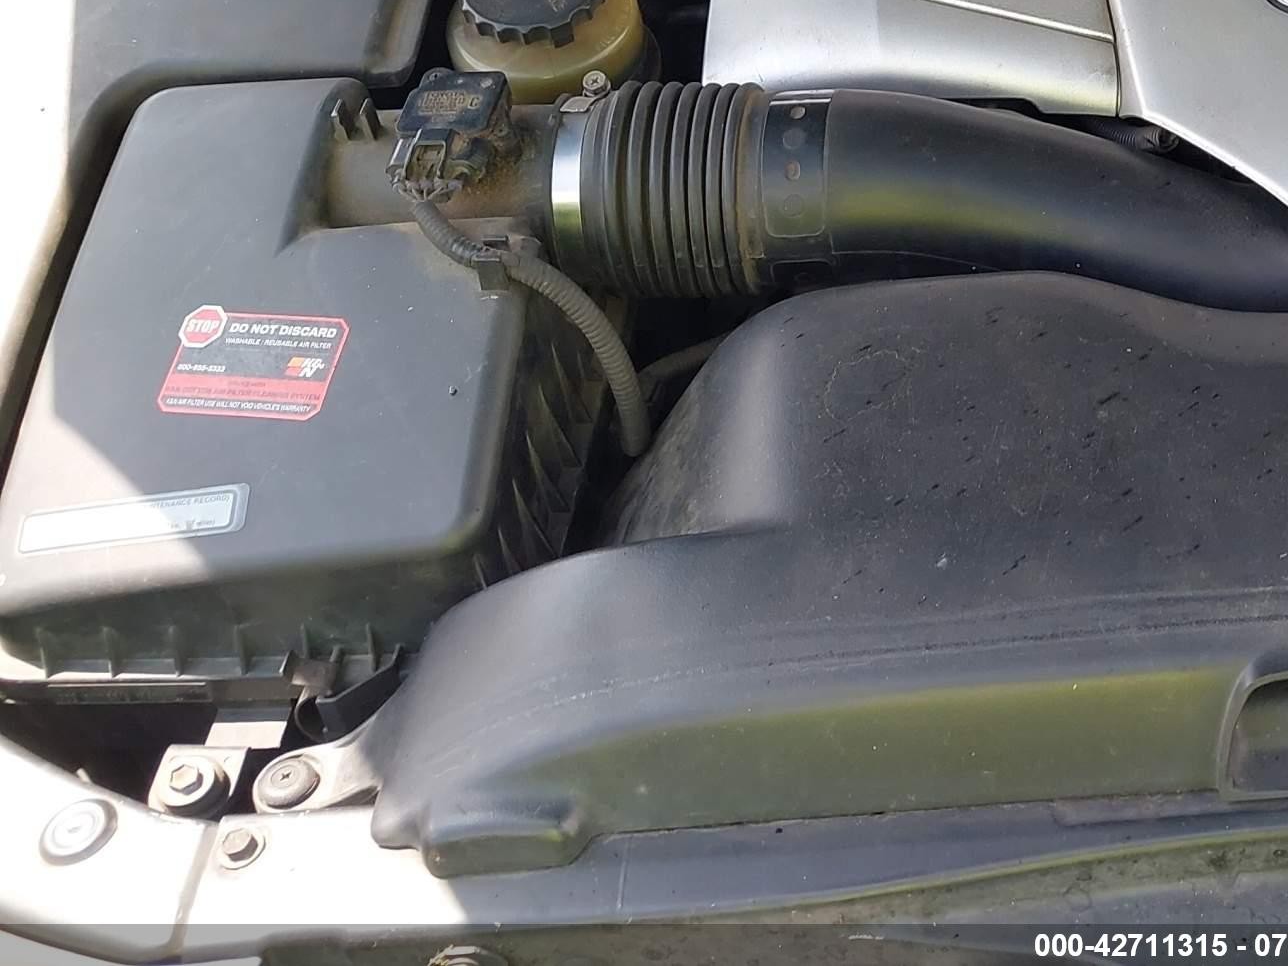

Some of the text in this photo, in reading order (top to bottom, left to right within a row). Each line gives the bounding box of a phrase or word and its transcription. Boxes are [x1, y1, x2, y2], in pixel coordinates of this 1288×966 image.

[187, 319, 220, 333] STOP
[229, 323, 337, 338] DO NOT DISCARD
[310, 342, 332, 350] FILTER
